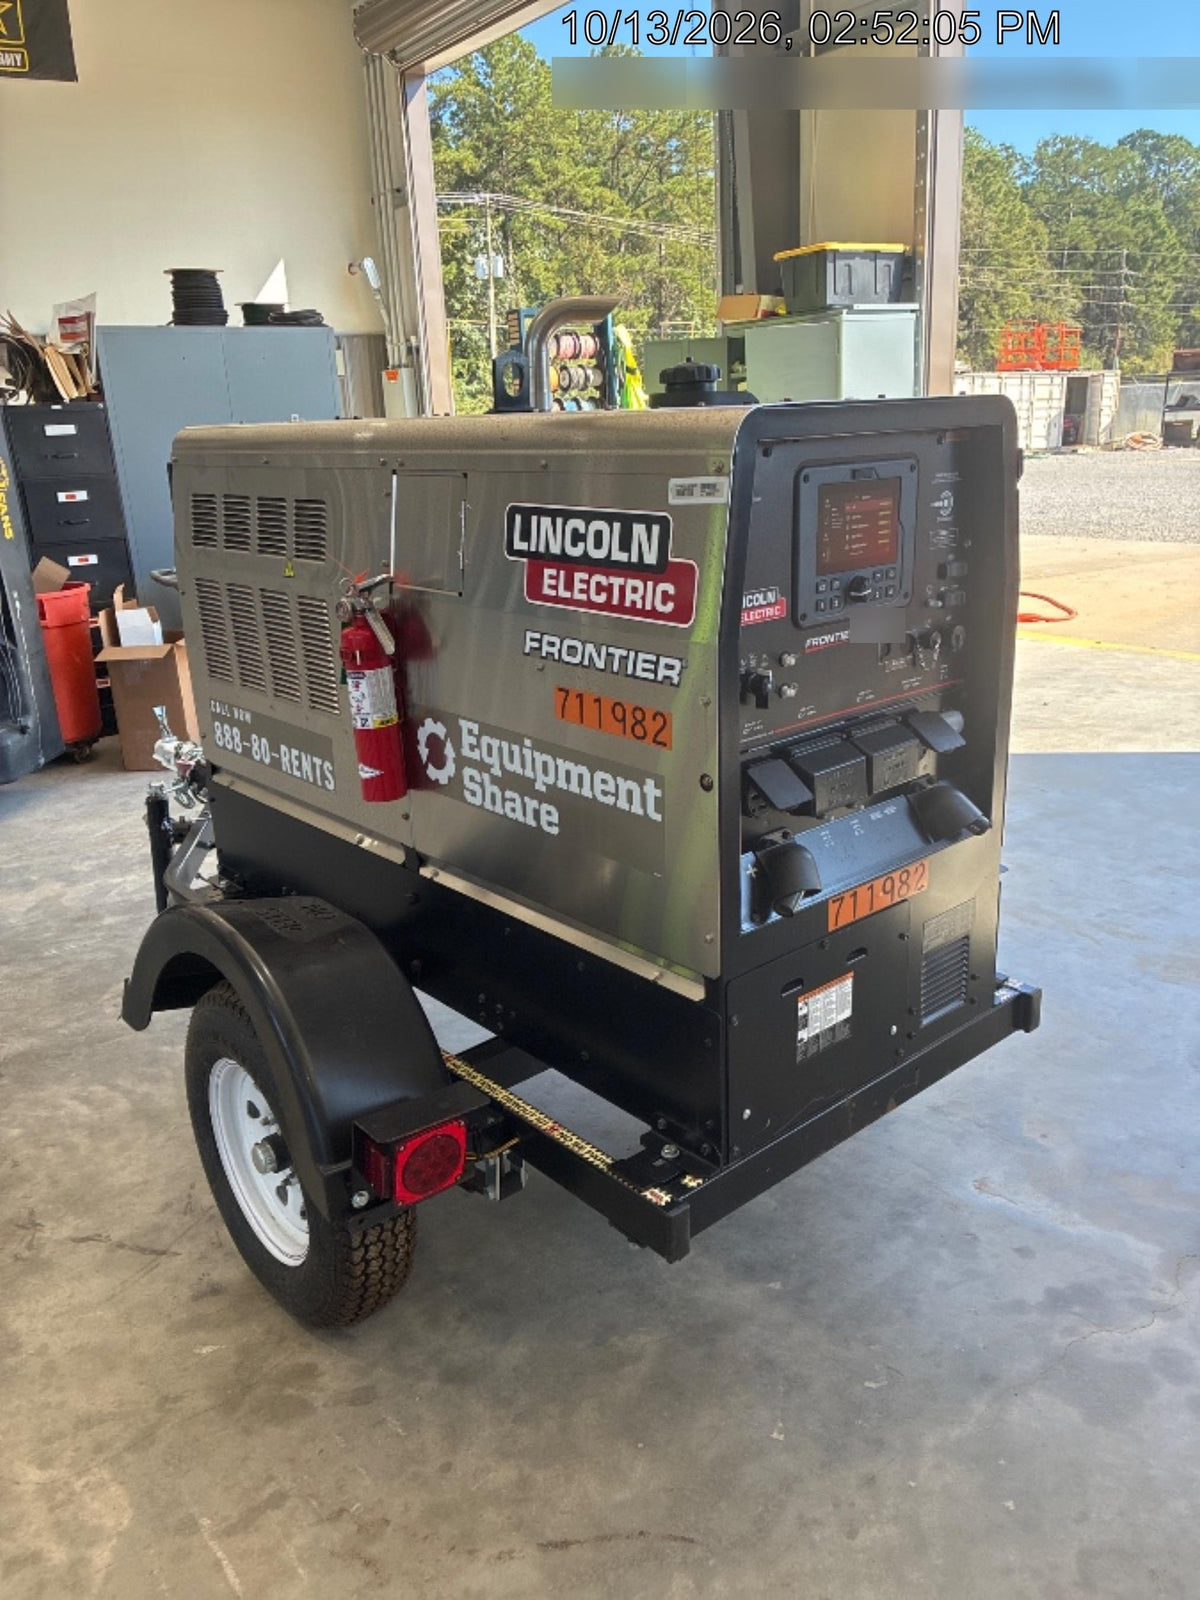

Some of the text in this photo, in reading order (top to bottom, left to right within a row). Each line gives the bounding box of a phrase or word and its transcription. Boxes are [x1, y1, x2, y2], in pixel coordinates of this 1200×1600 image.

[513, 513, 660, 566] LINCOLN
[542, 567, 675, 613] ELECTRIC
[523, 629, 684, 687] FRONTIER
[557, 687, 668, 748] 711982
[214, 721, 335, 791] 888-80-RENTS
[458, 718, 663, 822] Equipment
[462, 766, 560, 835] Share
[831, 862, 926, 927] 711982
